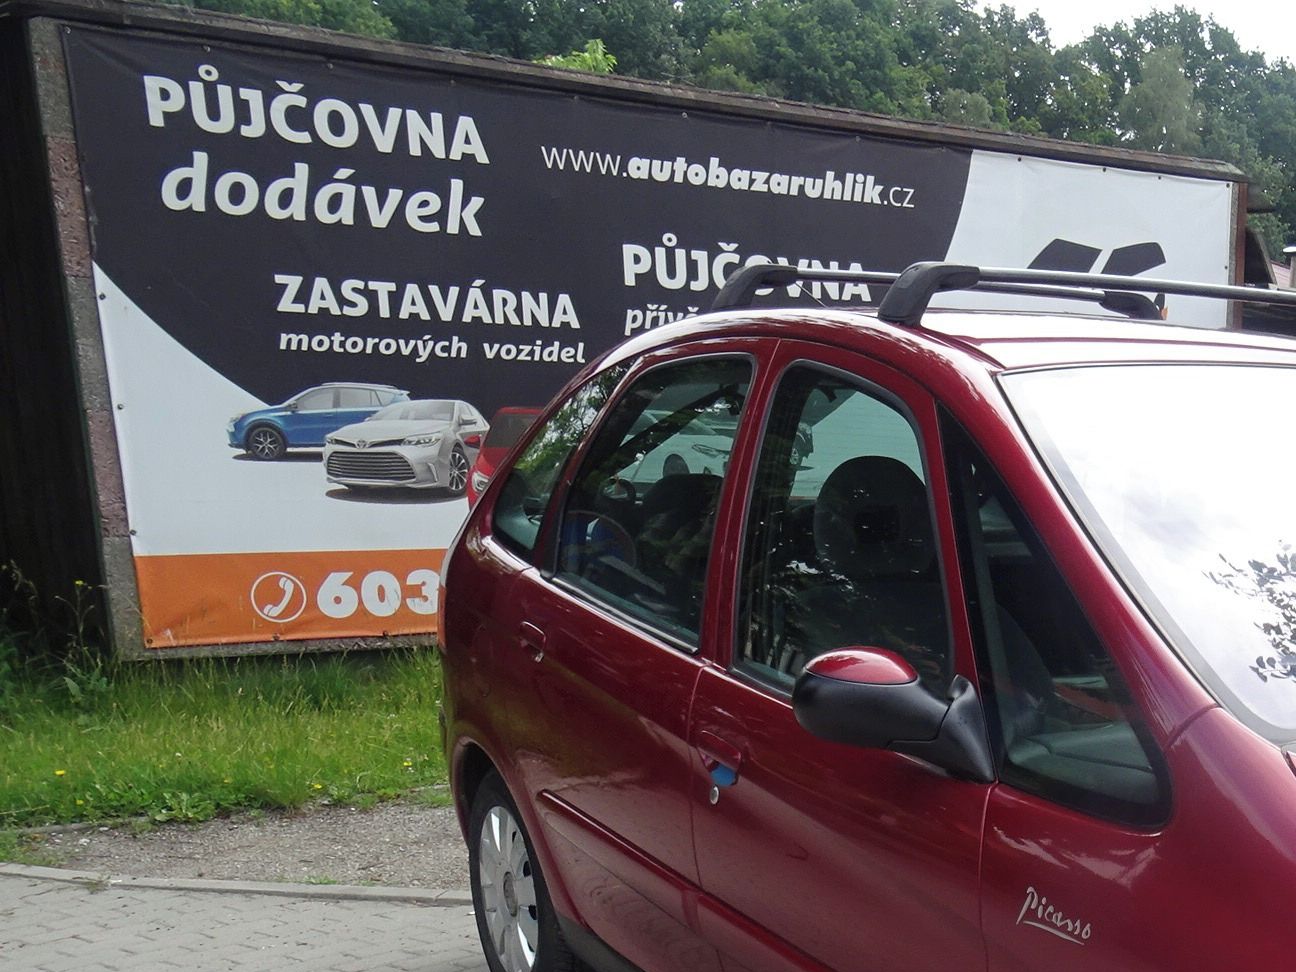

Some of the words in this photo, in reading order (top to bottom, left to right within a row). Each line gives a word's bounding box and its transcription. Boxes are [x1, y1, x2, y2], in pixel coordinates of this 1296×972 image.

[143, 64, 490, 164] PŮJČOVNA
[161, 151, 486, 236] dodávek
[541, 146, 915, 208] www.autobazaruhlik.cz
[274, 274, 581, 329] ZASTAVÁRNA
[279, 332, 467, 362] motorových
[483, 340, 586, 363] vozidel
[316, 569, 439, 619] 603
[1016, 886, 1091, 943] Picasso
